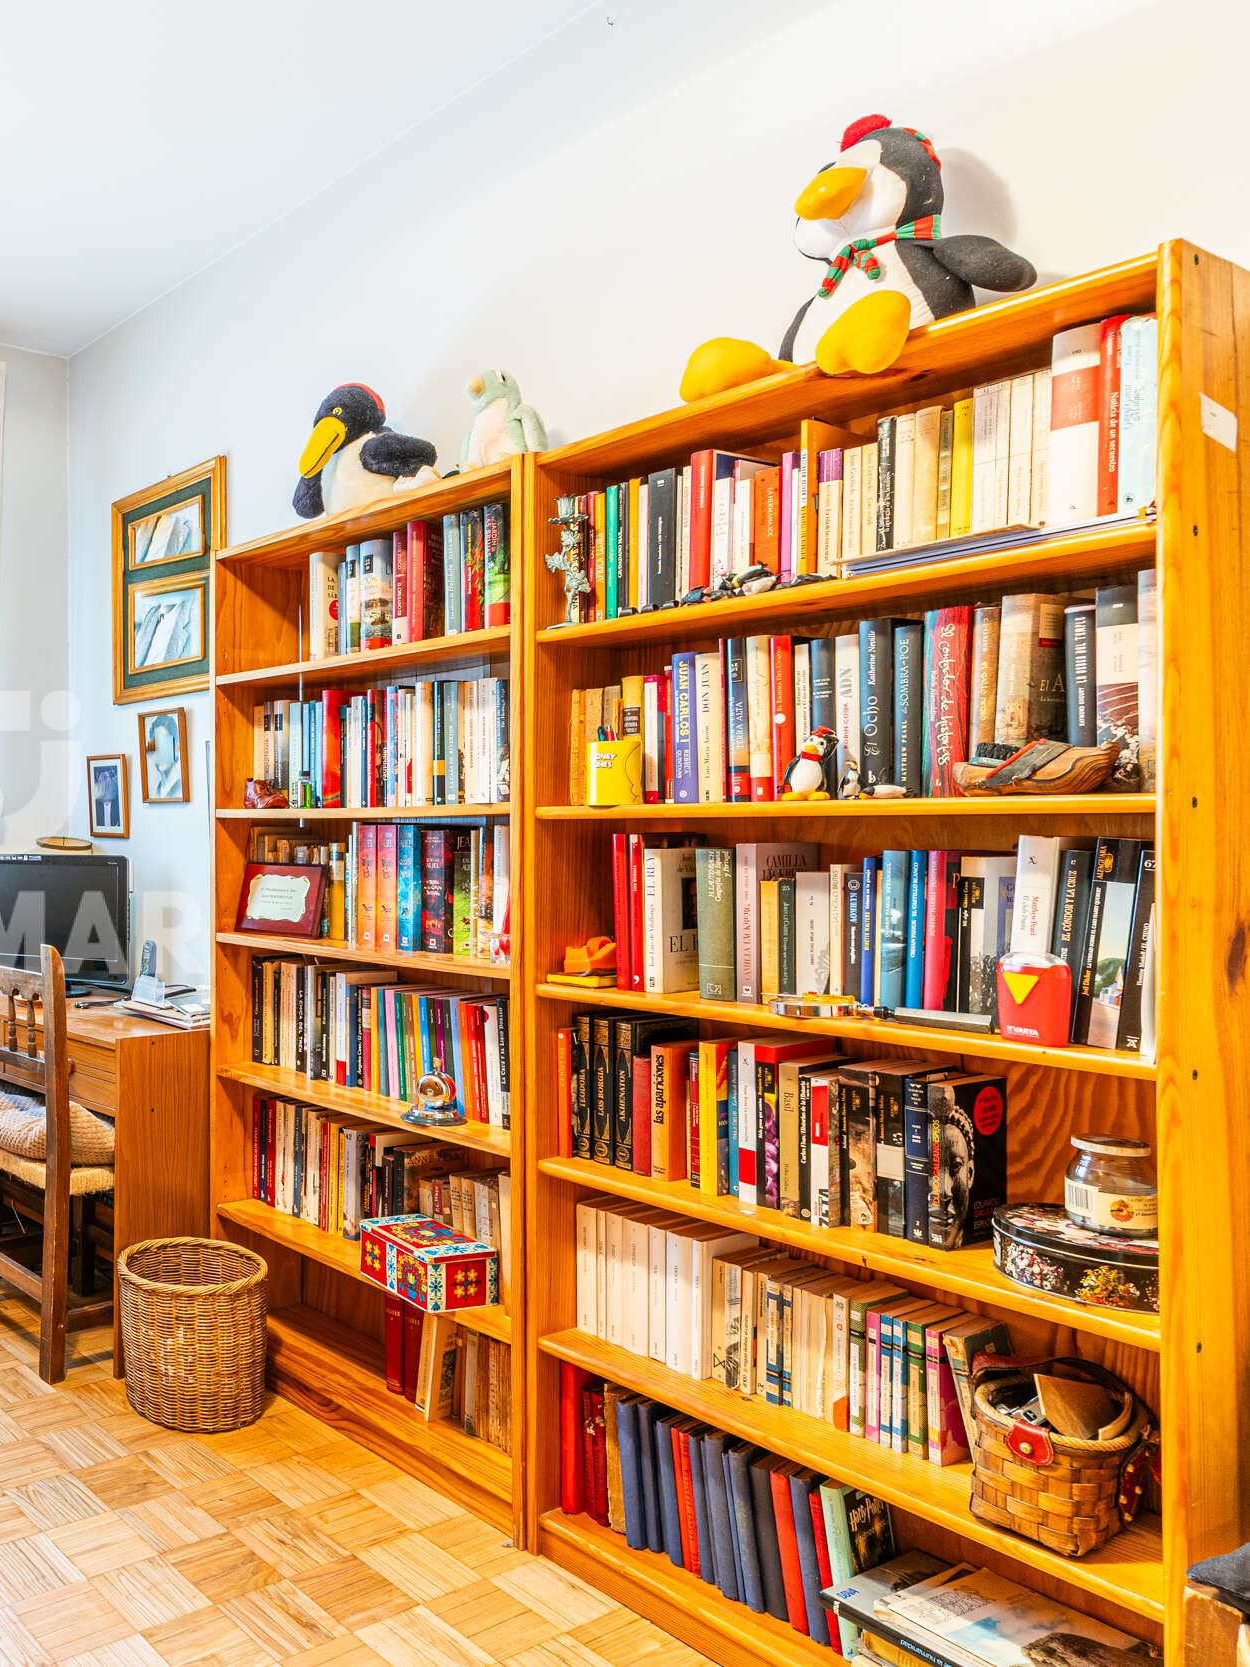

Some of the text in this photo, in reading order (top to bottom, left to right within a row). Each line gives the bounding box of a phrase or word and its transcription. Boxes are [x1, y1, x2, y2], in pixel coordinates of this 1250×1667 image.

[1109, 392, 1118, 417] Noticia
[1109, 419, 1118, 428] de
[1108, 440, 1116, 472] secuestro
[868, 630, 876, 685] Katherine Neville
[900, 639, 909, 705] SOMBRA POE
[939, 641, 955, 695] contador
[679, 661, 689, 690] JUAN
[701, 663, 710, 712] DON JUAN
[839, 667, 852, 698] ADN
[679, 693, 689, 737] CARLOS
[735, 701, 743, 721] ALTA
[862, 696, 879, 736] Ocho
[939, 696, 955, 712] de
[935, 716, 954, 765] historias
[646, 854, 655, 895] EL REY
[1095, 845, 1108, 879] ALFAGUARA
[1067, 870, 1078, 887] CRUZ
[849, 893, 857, 923] KURKOV
[1095, 886, 1103, 904] QUEBERT
[1030, 896, 1038, 936] Matthew Pearl
[1062, 903, 1074, 931] CÓNDOR
[670, 935, 689, 953] EL
[1061, 932, 1071, 941] EL
[1142, 922, 1150, 940] CHINO
[1083, 969, 1092, 985] Dicker
[1014, 1026, 1040, 1036] VARTA
[654, 1055, 666, 1124] las apariciones
[784, 1092, 794, 1112] Basil
[932, 1119, 940, 1142] ESPEJOS
[932, 1142, 940, 1176] GALEANO
[849, 1497, 885, 1532] Harry Potter
[900, 1638, 937, 1663] humanidad
